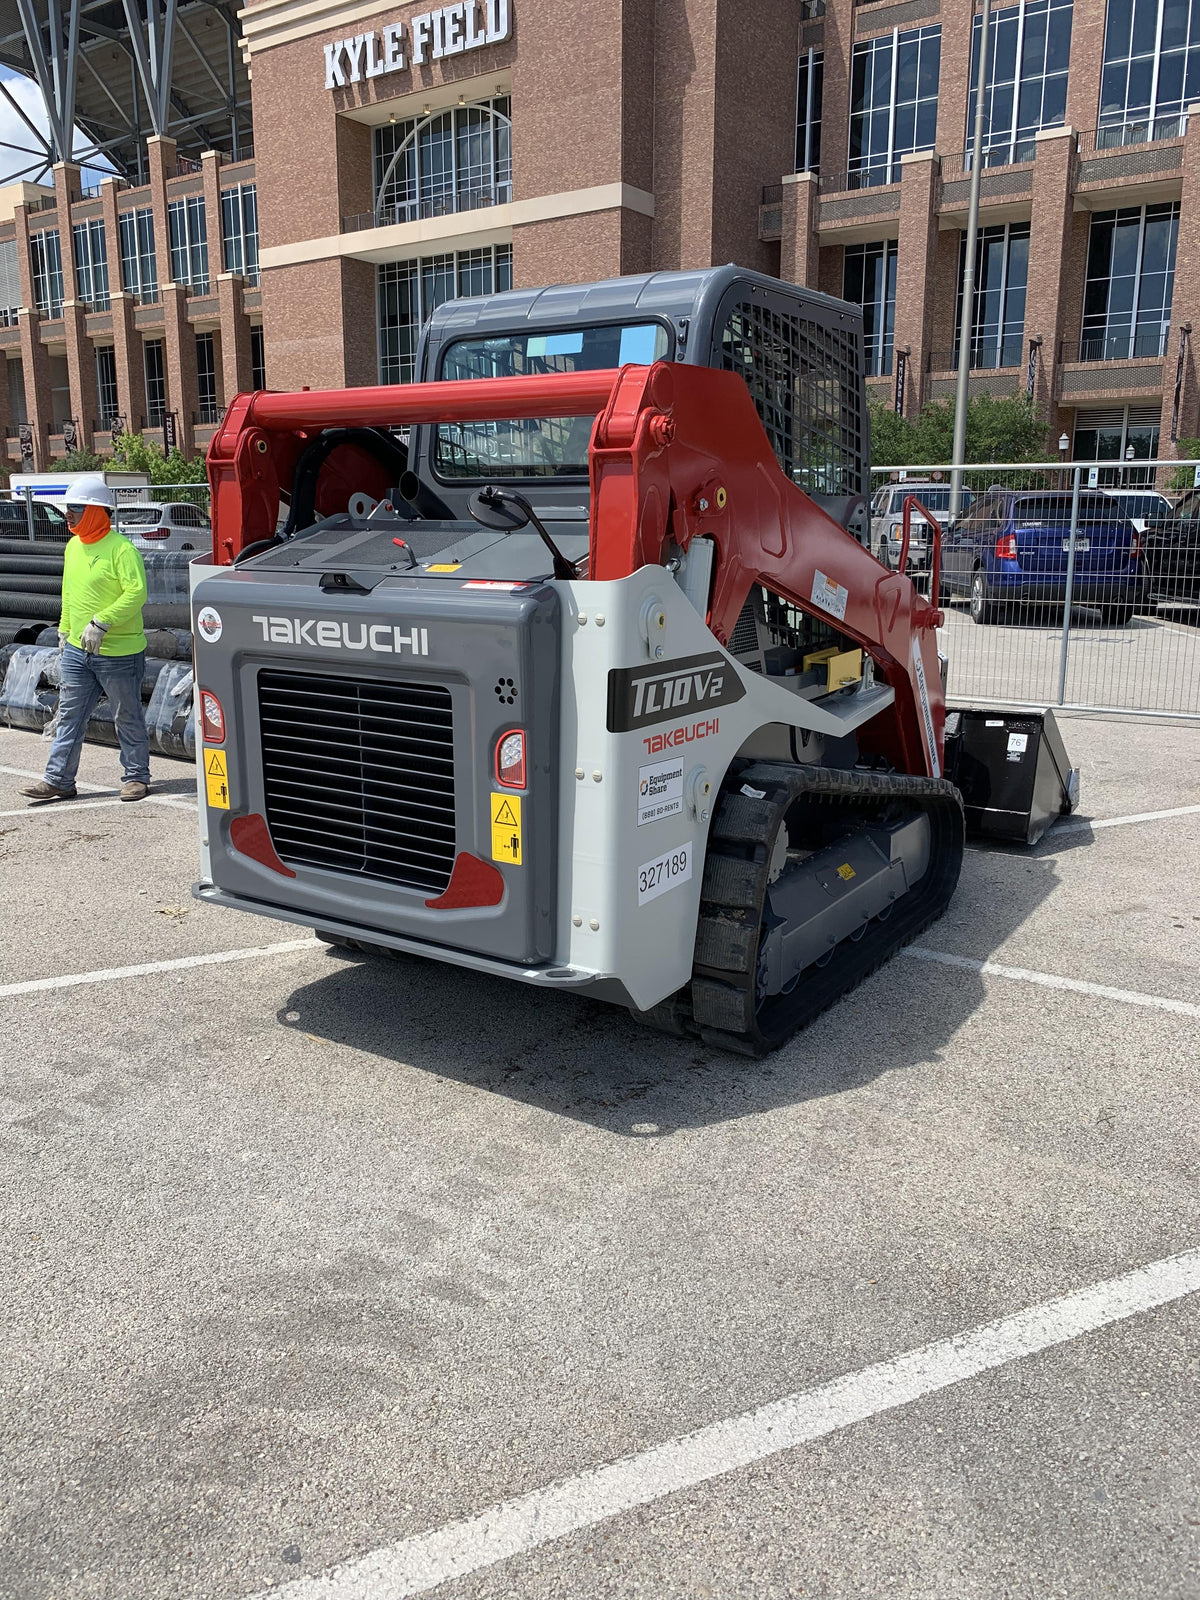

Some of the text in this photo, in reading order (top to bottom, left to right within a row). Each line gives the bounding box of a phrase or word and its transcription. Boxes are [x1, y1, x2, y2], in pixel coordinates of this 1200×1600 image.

[323, 0, 513, 90] KYLE FIELD
[252, 615, 429, 656] TAKEUCHI
[643, 718, 719, 755] TAKEUCHI
[649, 768, 683, 786] Equipment
[649, 784, 668, 796] Share
[639, 851, 687, 893] 327189
